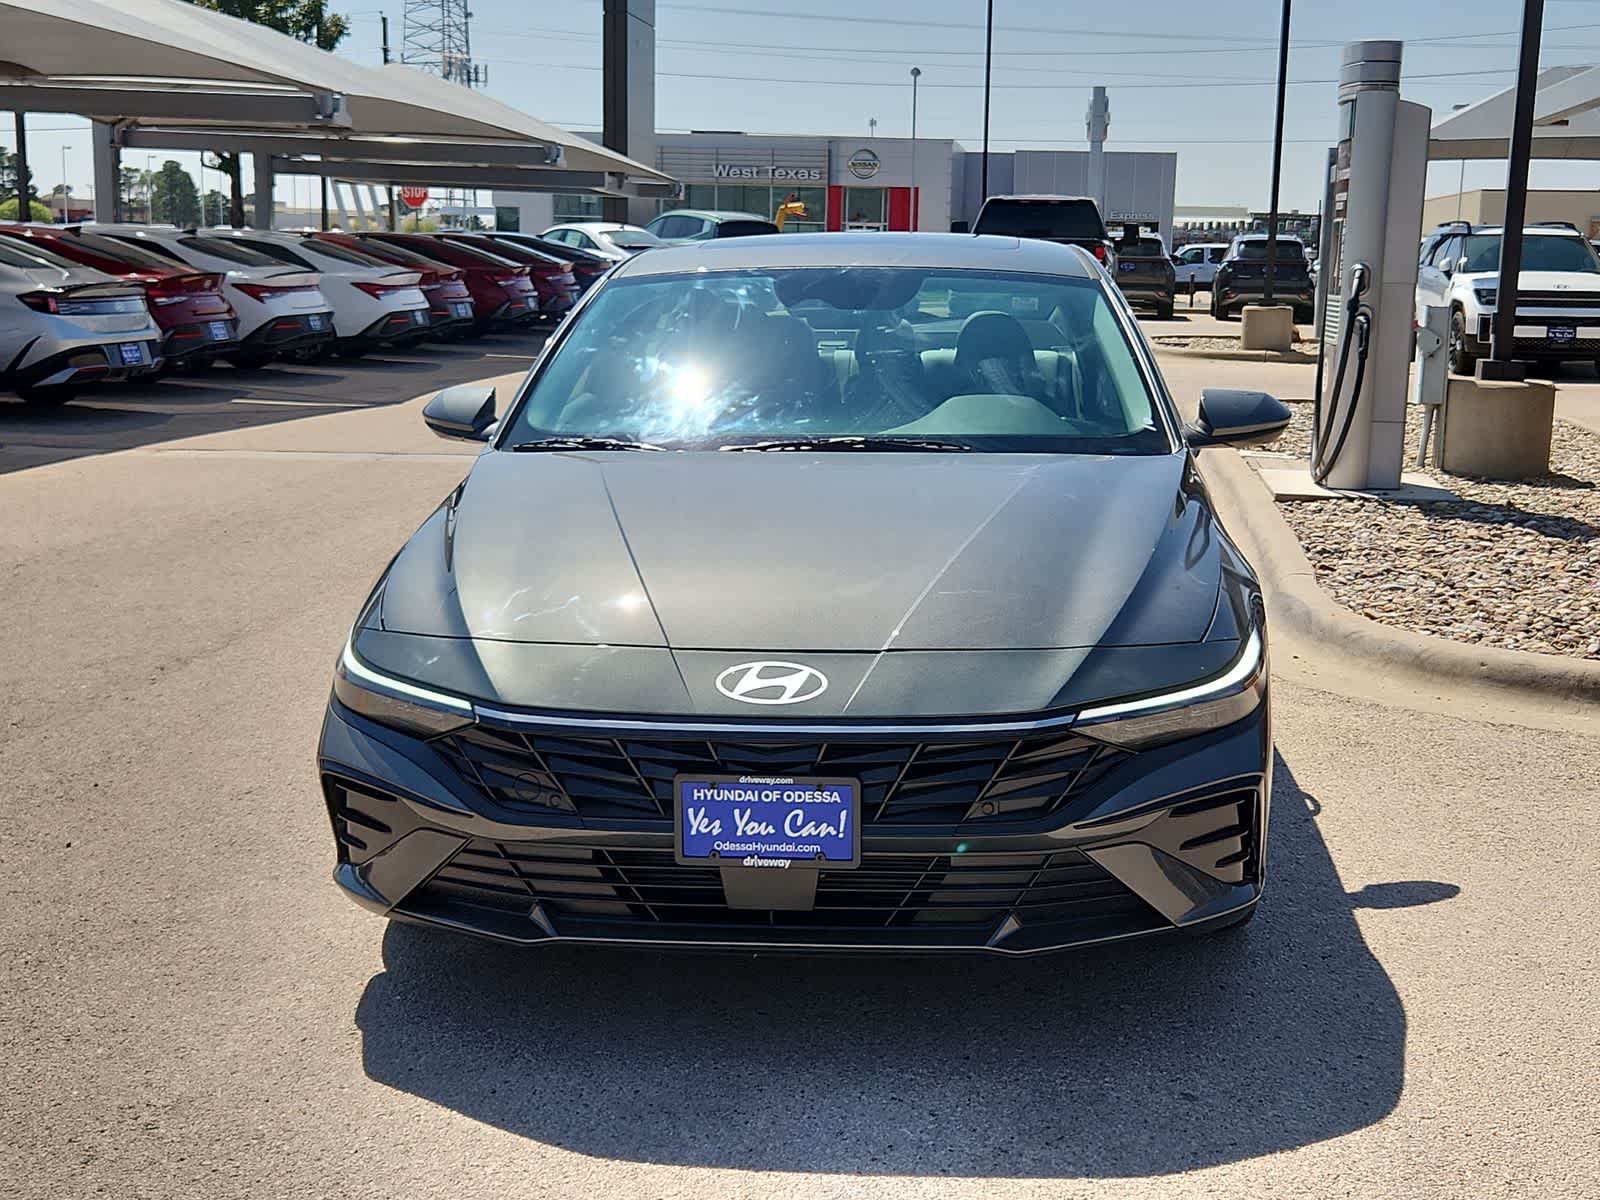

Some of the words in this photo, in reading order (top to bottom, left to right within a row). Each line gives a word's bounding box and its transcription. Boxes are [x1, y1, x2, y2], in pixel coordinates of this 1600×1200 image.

[712, 163, 759, 179] West
[765, 165, 821, 181] Texas
[403, 186, 427, 198] STOP
[739, 776, 794, 785] driveway.com
[693, 789, 759, 802] HYUNDAI
[761, 791, 781, 802] OF
[783, 792, 841, 803] ODESSA
[687, 807, 722, 836] Yes
[733, 808, 775, 836] You
[784, 809, 847, 838] Can!
[714, 840, 820, 853] OdessaHyundai.com
[743, 855, 791, 868] driveway
